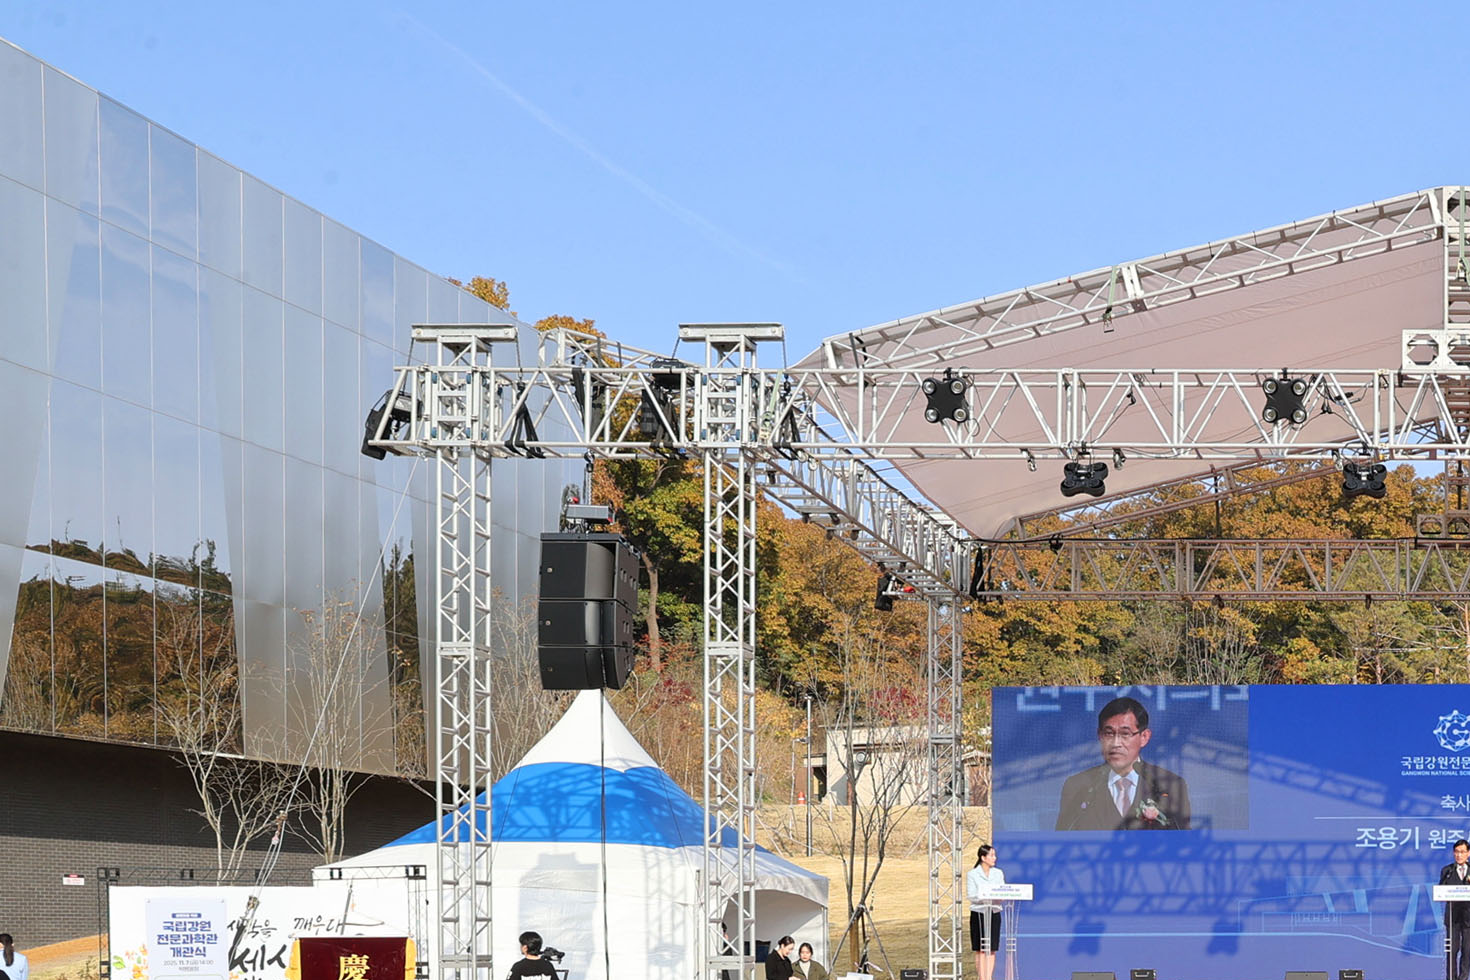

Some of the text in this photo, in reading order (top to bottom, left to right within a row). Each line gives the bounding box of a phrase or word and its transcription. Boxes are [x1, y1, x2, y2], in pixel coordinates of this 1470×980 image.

[1355, 826, 1420, 850] 조용기
[163, 920, 212, 932] 국립강원
[157, 933, 218, 945] 전문과학관
[169, 946, 207, 958] 개관식
